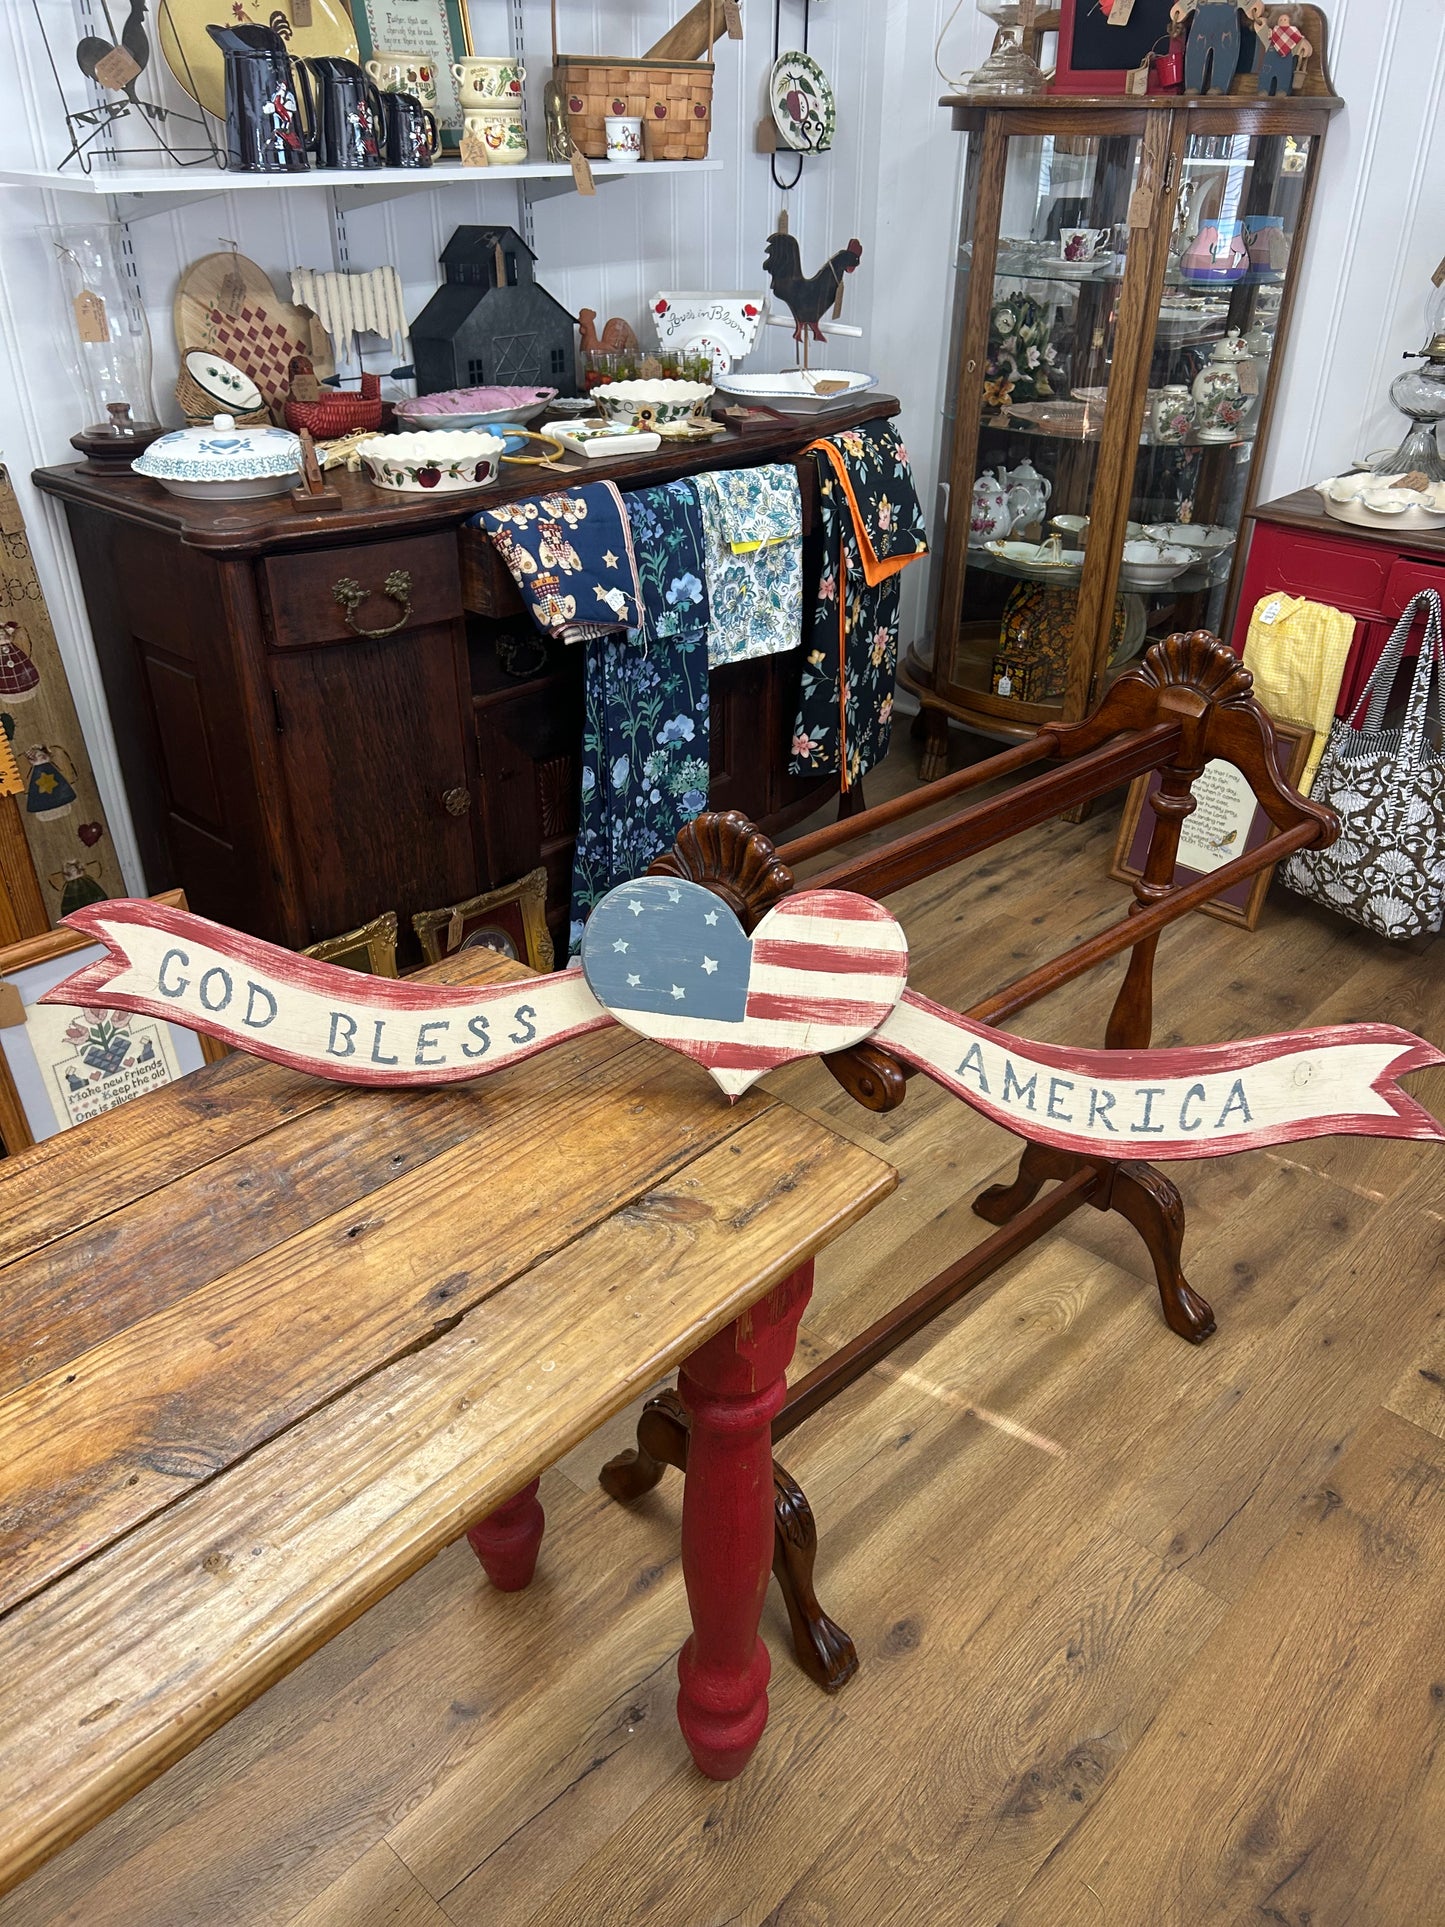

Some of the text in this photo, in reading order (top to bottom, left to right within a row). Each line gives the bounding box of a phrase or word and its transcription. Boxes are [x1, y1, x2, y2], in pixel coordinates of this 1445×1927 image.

[157, 948, 1253, 1132] GOD BLESS AMERICA
[68, 1086, 102, 1105] Make
[103, 1078, 123, 1091] new
[101, 1067, 166, 1101] Keep the old
[76, 1108, 98, 1122] One
[100, 1103, 109, 1114] is
